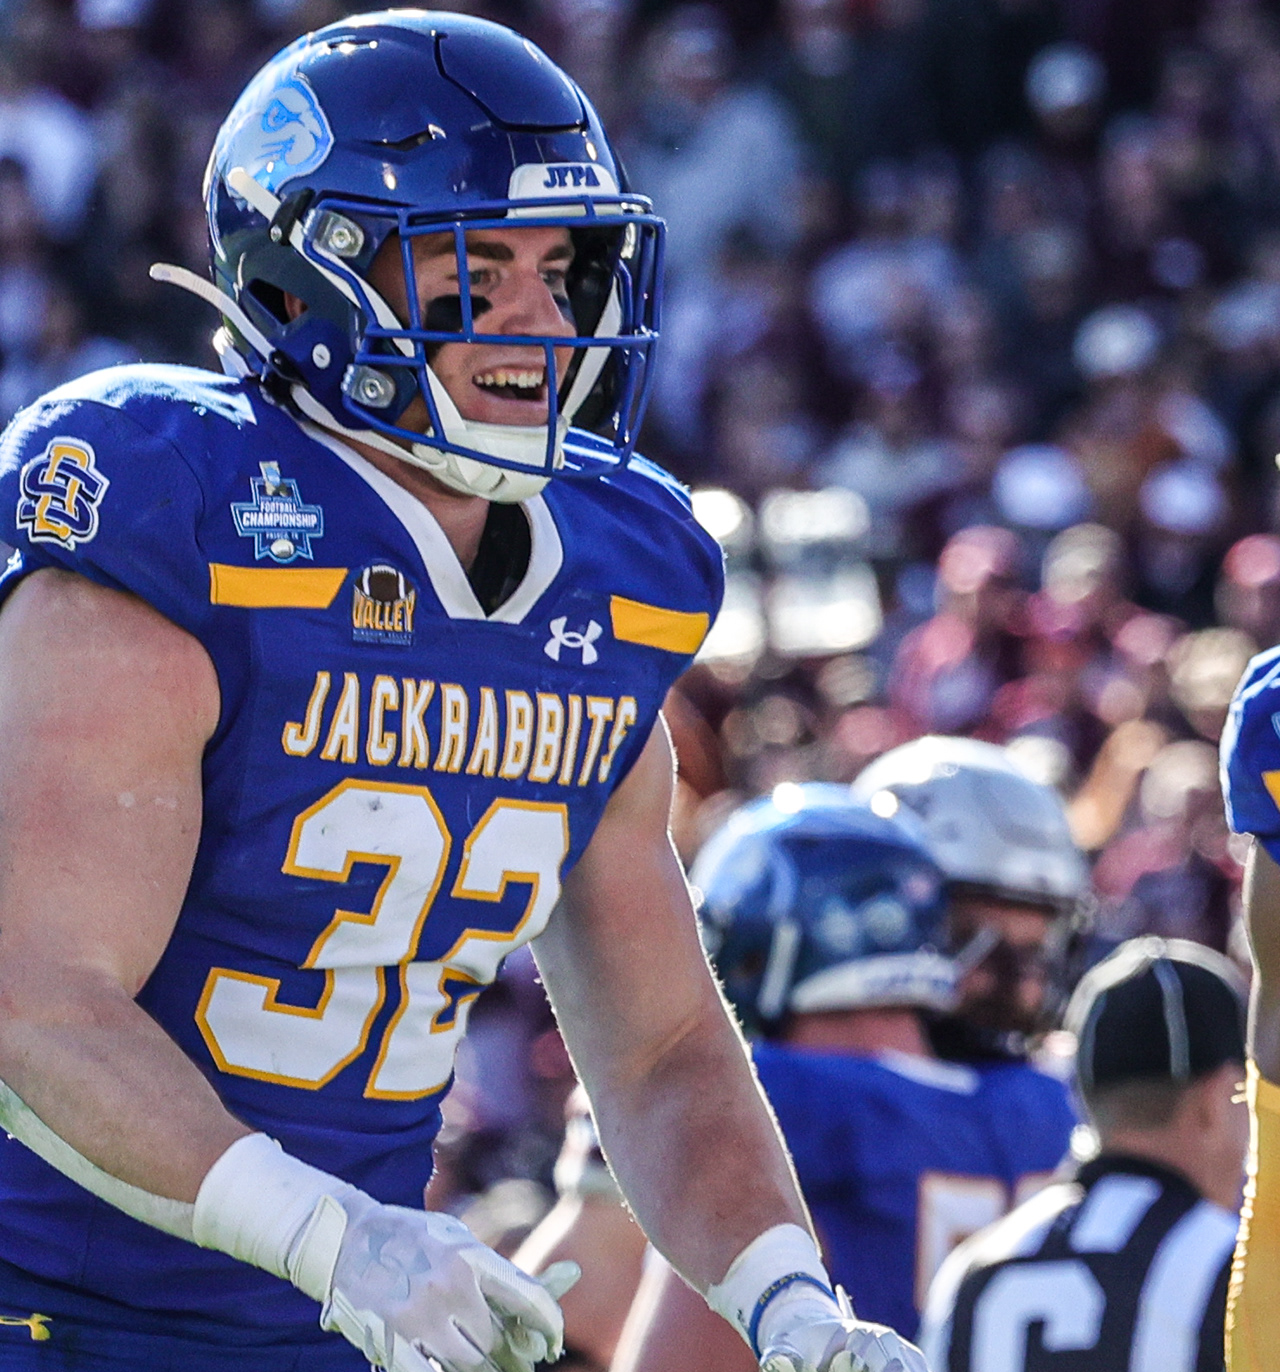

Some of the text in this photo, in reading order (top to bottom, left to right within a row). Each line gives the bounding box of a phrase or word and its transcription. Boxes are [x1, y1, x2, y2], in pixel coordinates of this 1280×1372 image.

[242, 512, 317, 528] CHAMPIONSHIP
[260, 502, 298, 513] FOOTBALL
[352, 584, 416, 632] VALLEY
[282, 671, 638, 786] JACKRABBITS
[195, 778, 569, 1101] 32
